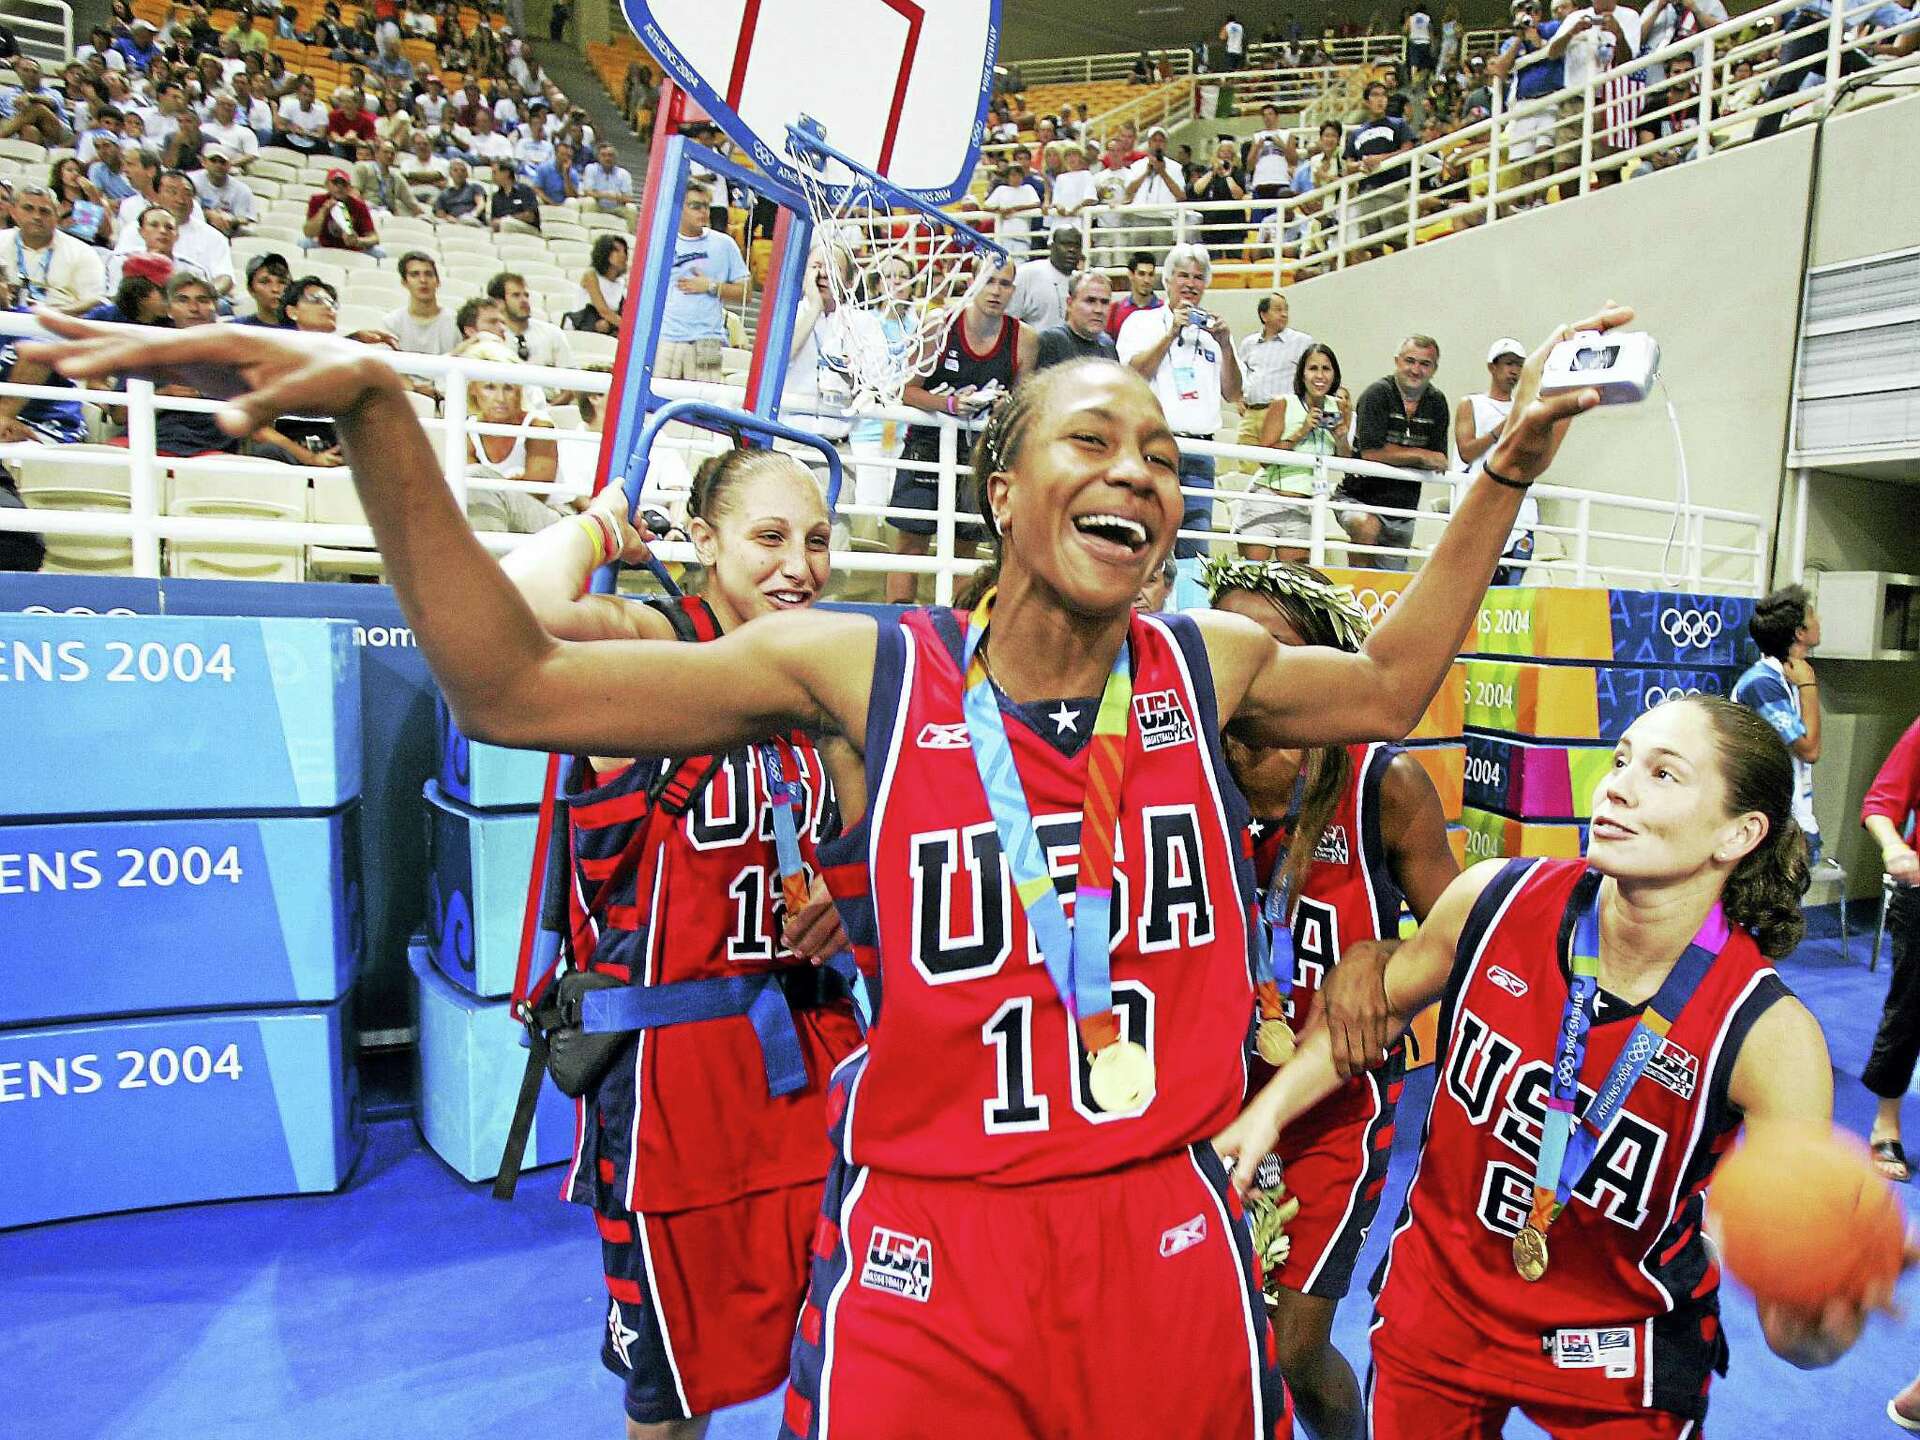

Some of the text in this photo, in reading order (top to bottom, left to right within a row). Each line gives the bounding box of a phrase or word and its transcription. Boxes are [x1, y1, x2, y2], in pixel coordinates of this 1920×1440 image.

[1495, 608, 1531, 634] 2004
[105, 641, 236, 683] 2004
[1132, 689, 1188, 731] USA
[1475, 682, 1513, 710] 2004
[1464, 756, 1500, 787] 2004
[1464, 828, 1499, 858] 2004
[0, 845, 243, 894] ENS 2004
[1565, 991, 1585, 1054] ATHENS 2004
[0, 1043, 243, 1102] ENS 2004
[1598, 1062, 1634, 1120] ATHENS 2004
[1446, 1008, 1669, 1231] USA
[868, 1228, 931, 1278] USA
